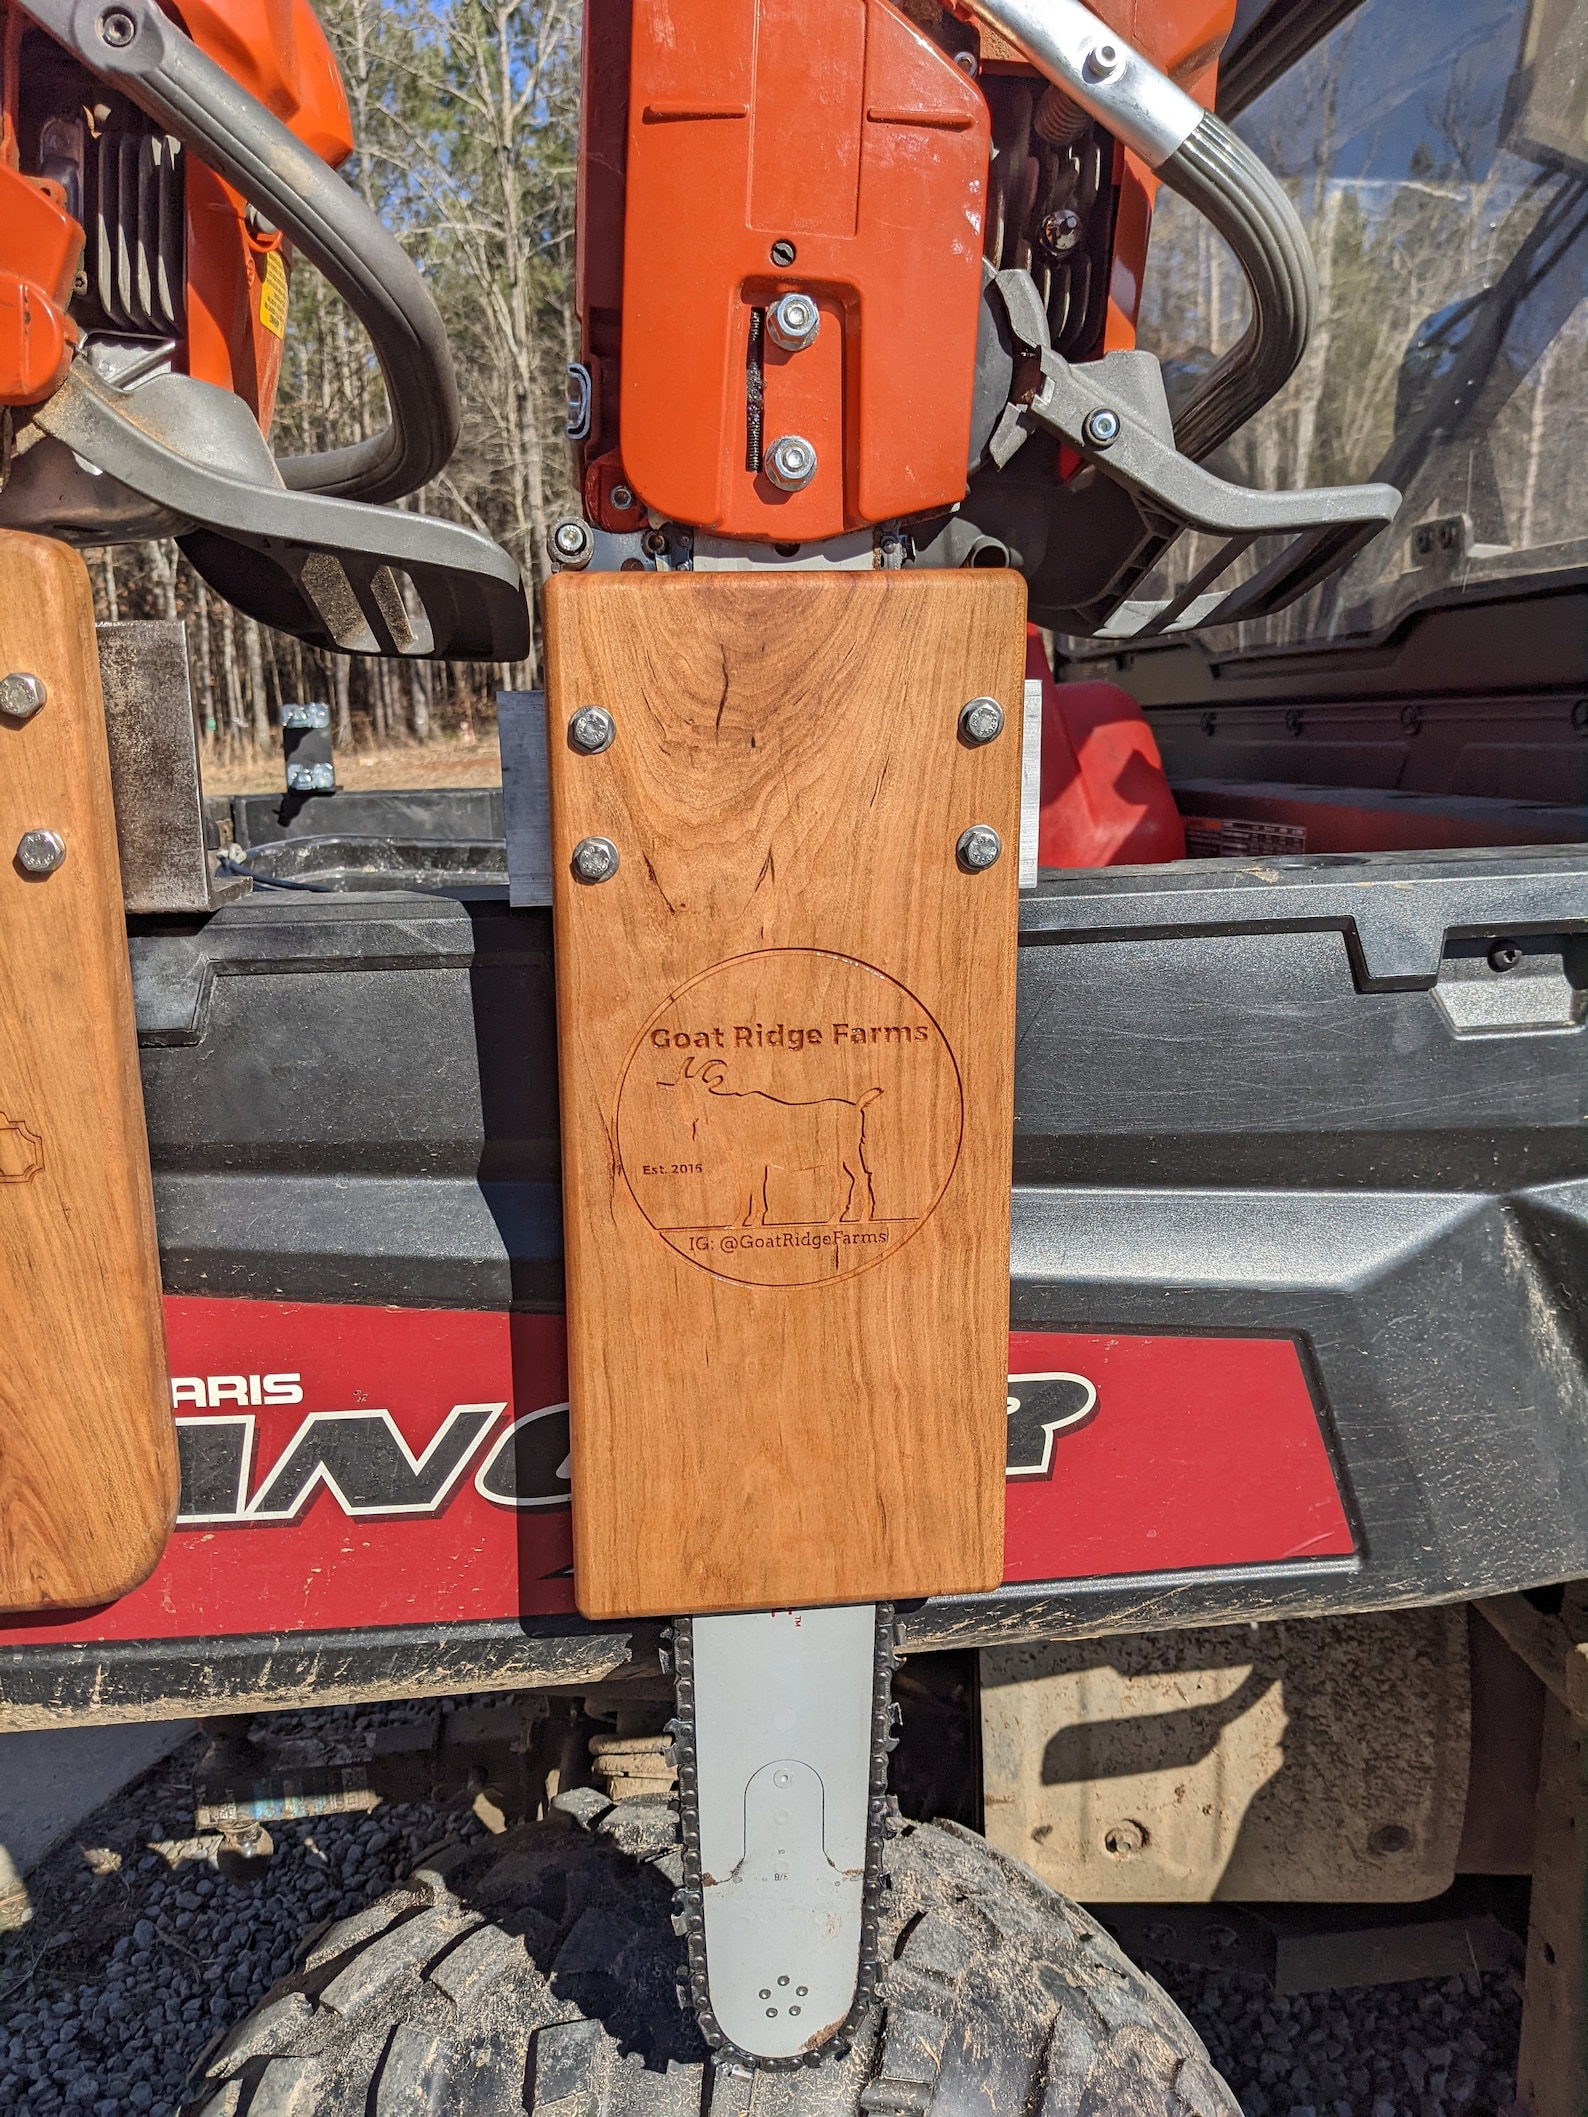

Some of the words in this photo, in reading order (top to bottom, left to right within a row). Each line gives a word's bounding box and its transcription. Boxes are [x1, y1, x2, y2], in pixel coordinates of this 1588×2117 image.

[650, 1027, 725, 1049] Goat
[733, 1023, 822, 1050] Ridge
[832, 1022, 929, 1045] Farms
[642, 1165, 668, 1175] Est.
[689, 1236, 714, 1251] IG:
[720, 1230, 887, 1253] @GoatRidgeFarms
